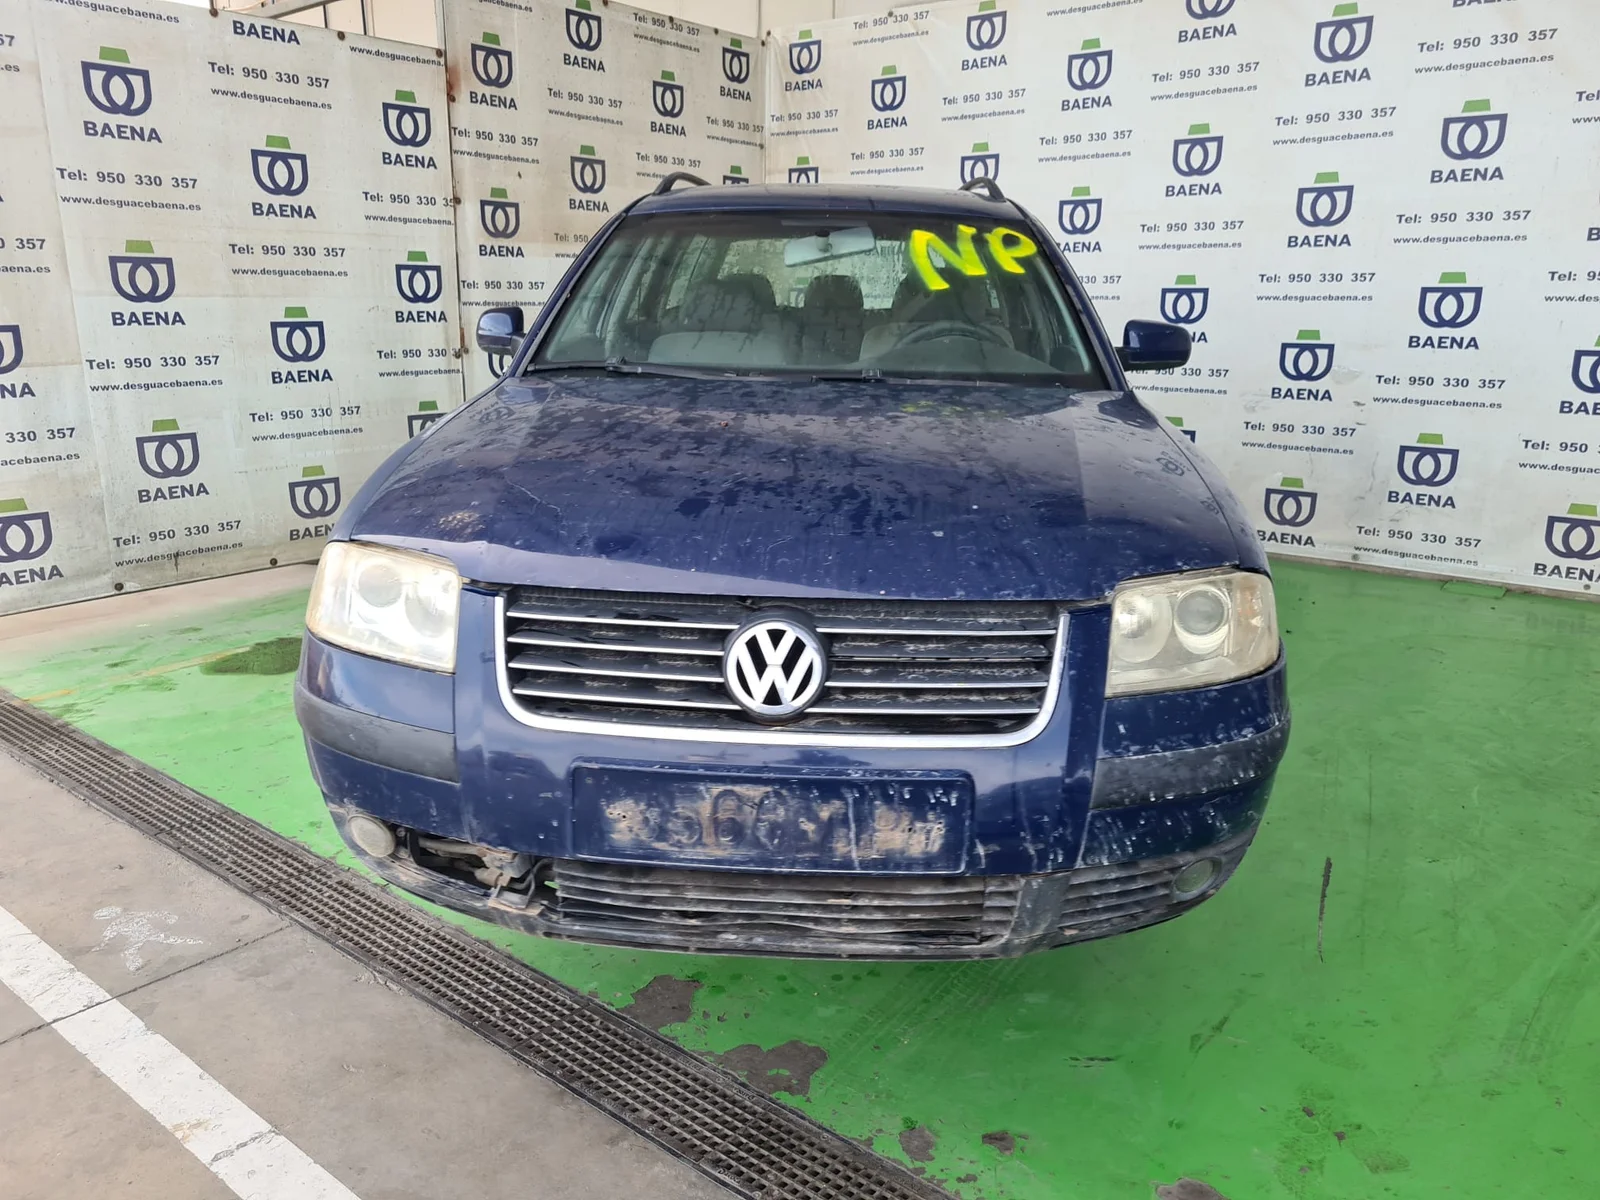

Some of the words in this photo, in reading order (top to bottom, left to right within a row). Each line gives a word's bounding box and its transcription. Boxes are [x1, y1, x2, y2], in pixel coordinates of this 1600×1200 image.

[853, 20, 869, 30] Tel:
[872, 17, 889, 27] 950
[892, 13, 909, 24] 330
[913, 10, 930, 21] 357
[231, 19, 301, 46] BAENA
[1177, 22, 1238, 44] BAENA
[1417, 40, 1445, 53] Tel:
[1453, 36, 1481, 50] 950
[1489, 31, 1519, 46] 330
[1527, 27, 1559, 42] 357
[562, 52, 606, 74] BAENA
[961, 53, 1008, 72] BAENA
[1414, 54, 1555, 74] www.desguacebaena.es
[207, 60, 235, 76] Tel:
[241, 66, 268, 81] 950
[274, 71, 300, 85] 330
[306, 75, 330, 90] 357
[1151, 71, 1173, 83] Tel:
[1179, 68, 1201, 80] 950
[1207, 64, 1230, 77] 330
[1236, 61, 1260, 74] 357
[1304, 67, 1372, 88] BAENA
[719, 85, 752, 103] BAENA
[784, 78, 824, 93] BAENA
[1150, 84, 1258, 101] www.desguacebaena.es
[210, 87, 333, 110] www.desguacebaena.es
[469, 90, 518, 111] BAENA
[546, 87, 564, 100] Tel:
[567, 91, 584, 103] 950
[588, 94, 604, 107] 330
[607, 98, 623, 110] 357
[942, 96, 958, 106] Tel:
[962, 93, 981, 104] 950
[985, 90, 1003, 102] 330
[1007, 88, 1026, 99] 357
[1060, 95, 1113, 112] BAENA
[866, 115, 908, 131] BAENA
[1274, 115, 1299, 127] Tel:
[1305, 112, 1330, 125] 950
[1337, 109, 1363, 122] 330
[1370, 106, 1397, 119] 357
[82, 120, 163, 144] BAENA
[451, 126, 471, 139] Tel:
[475, 129, 494, 142] 950
[498, 132, 517, 145] 330
[521, 135, 539, 147] 357
[650, 120, 687, 138] BAENA
[1039, 136, 1058, 146] Tel:
[1062, 133, 1082, 145] 950
[1087, 131, 1107, 142] 330
[1112, 129, 1133, 141] 357
[1272, 130, 1394, 146] www.desguacebaena.es
[381, 151, 438, 171] BAENA
[850, 151, 866, 161] Tel:
[869, 149, 885, 160] 950
[888, 148, 905, 158] 330
[908, 146, 925, 157] 357
[1038, 151, 1132, 163] www.desguacebaena.es
[55, 167, 88, 182] Tel:
[96, 170, 126, 185] 950
[134, 173, 163, 187] 330
[170, 176, 198, 190] 357
[1429, 166, 1505, 184] BAENA
[361, 190, 384, 203] Tel:
[389, 193, 411, 205] 950
[416, 195, 437, 207] 330
[1164, 182, 1223, 198] BAENA
[59, 195, 202, 211] www.desguacebaena.es
[251, 201, 317, 220] BAENA
[568, 197, 610, 213] BAENA
[1395, 213, 1422, 225] Tel:
[1430, 212, 1458, 224] 950
[1465, 210, 1494, 223] 330
[1502, 209, 1532, 222] 357
[1139, 223, 1160, 233] Tel:
[1166, 222, 1188, 233] 950
[1193, 221, 1216, 232] 330
[1221, 220, 1245, 231] 357
[14, 237, 46, 250] 357
[1138, 241, 1242, 251] www.desguacebaena.es
[1286, 233, 1352, 249] BAENA
[1393, 234, 1528, 245] www.desguacebaena.es
[228, 243, 255, 255] Tel:
[261, 244, 286, 256] 950
[292, 245, 317, 257] 330
[323, 246, 346, 258] 357
[478, 243, 525, 259] BAENA
[231, 267, 349, 278] www.desguacebaena.es
[1258, 273, 1281, 284] Tel:
[1288, 273, 1312, 284] 950
[1318, 272, 1344, 283] 330
[1350, 272, 1376, 283] 357
[1547, 270, 1578, 282] Tel:
[460, 279, 479, 290] Tel:
[484, 280, 502, 290] 950
[506, 280, 524, 291] 330
[528, 280, 545, 291] 357
[1256, 293, 1373, 303] www.desguacebaena.es
[110, 310, 187, 327] BAENA
[394, 309, 449, 324] BAENA
[1407, 335, 1480, 351] BAENA
[376, 349, 397, 360] Tel:
[401, 348, 422, 359] 950
[427, 345, 451, 358] 330
[85, 358, 116, 371] Tel:
[123, 356, 152, 369] 950
[159, 355, 187, 368] 330
[194, 354, 220, 367] 357
[270, 368, 334, 385] BAENA
[1180, 367, 1202, 377] 330
[1207, 368, 1230, 378] 357
[89, 379, 224, 392] www.desguacebaena.es
[1375, 374, 1401, 386] Tel:
[1408, 375, 1435, 387] 950
[1442, 377, 1470, 389] 330
[1477, 378, 1506, 390] 357
[1270, 386, 1333, 403] BAENA
[1372, 396, 1503, 409] www.desguacebaena.es
[248, 411, 274, 423] Tel:
[280, 409, 304, 421] 950
[310, 406, 333, 419] 330
[339, 405, 361, 417] 357
[4, 430, 38, 444] 330
[46, 426, 76, 441] 357
[251, 427, 364, 442] www.desguacebaena.es
[1243, 420, 1266, 432] Tel:
[1271, 422, 1295, 434] 950
[1301, 424, 1326, 436] 330
[1331, 426, 1357, 438] 357
[1241, 441, 1354, 456] www.desguacebaena.es
[1521, 438, 1550, 451] Tel:
[1558, 441, 1589, 454] 950
[137, 482, 210, 504] BAENA
[1387, 490, 1457, 510] BAENA
[112, 534, 141, 549] Tel:
[148, 528, 176, 542] 950
[183, 524, 210, 538] 330
[217, 519, 242, 533] 357
[1356, 525, 1381, 537] Tel:
[1387, 528, 1413, 541] 950
[1420, 532, 1447, 545] 330
[1454, 536, 1482, 549] 357
[114, 541, 244, 567] www.desguacebaena.es
[1353, 546, 1479, 567] www.desguacebaena.es
